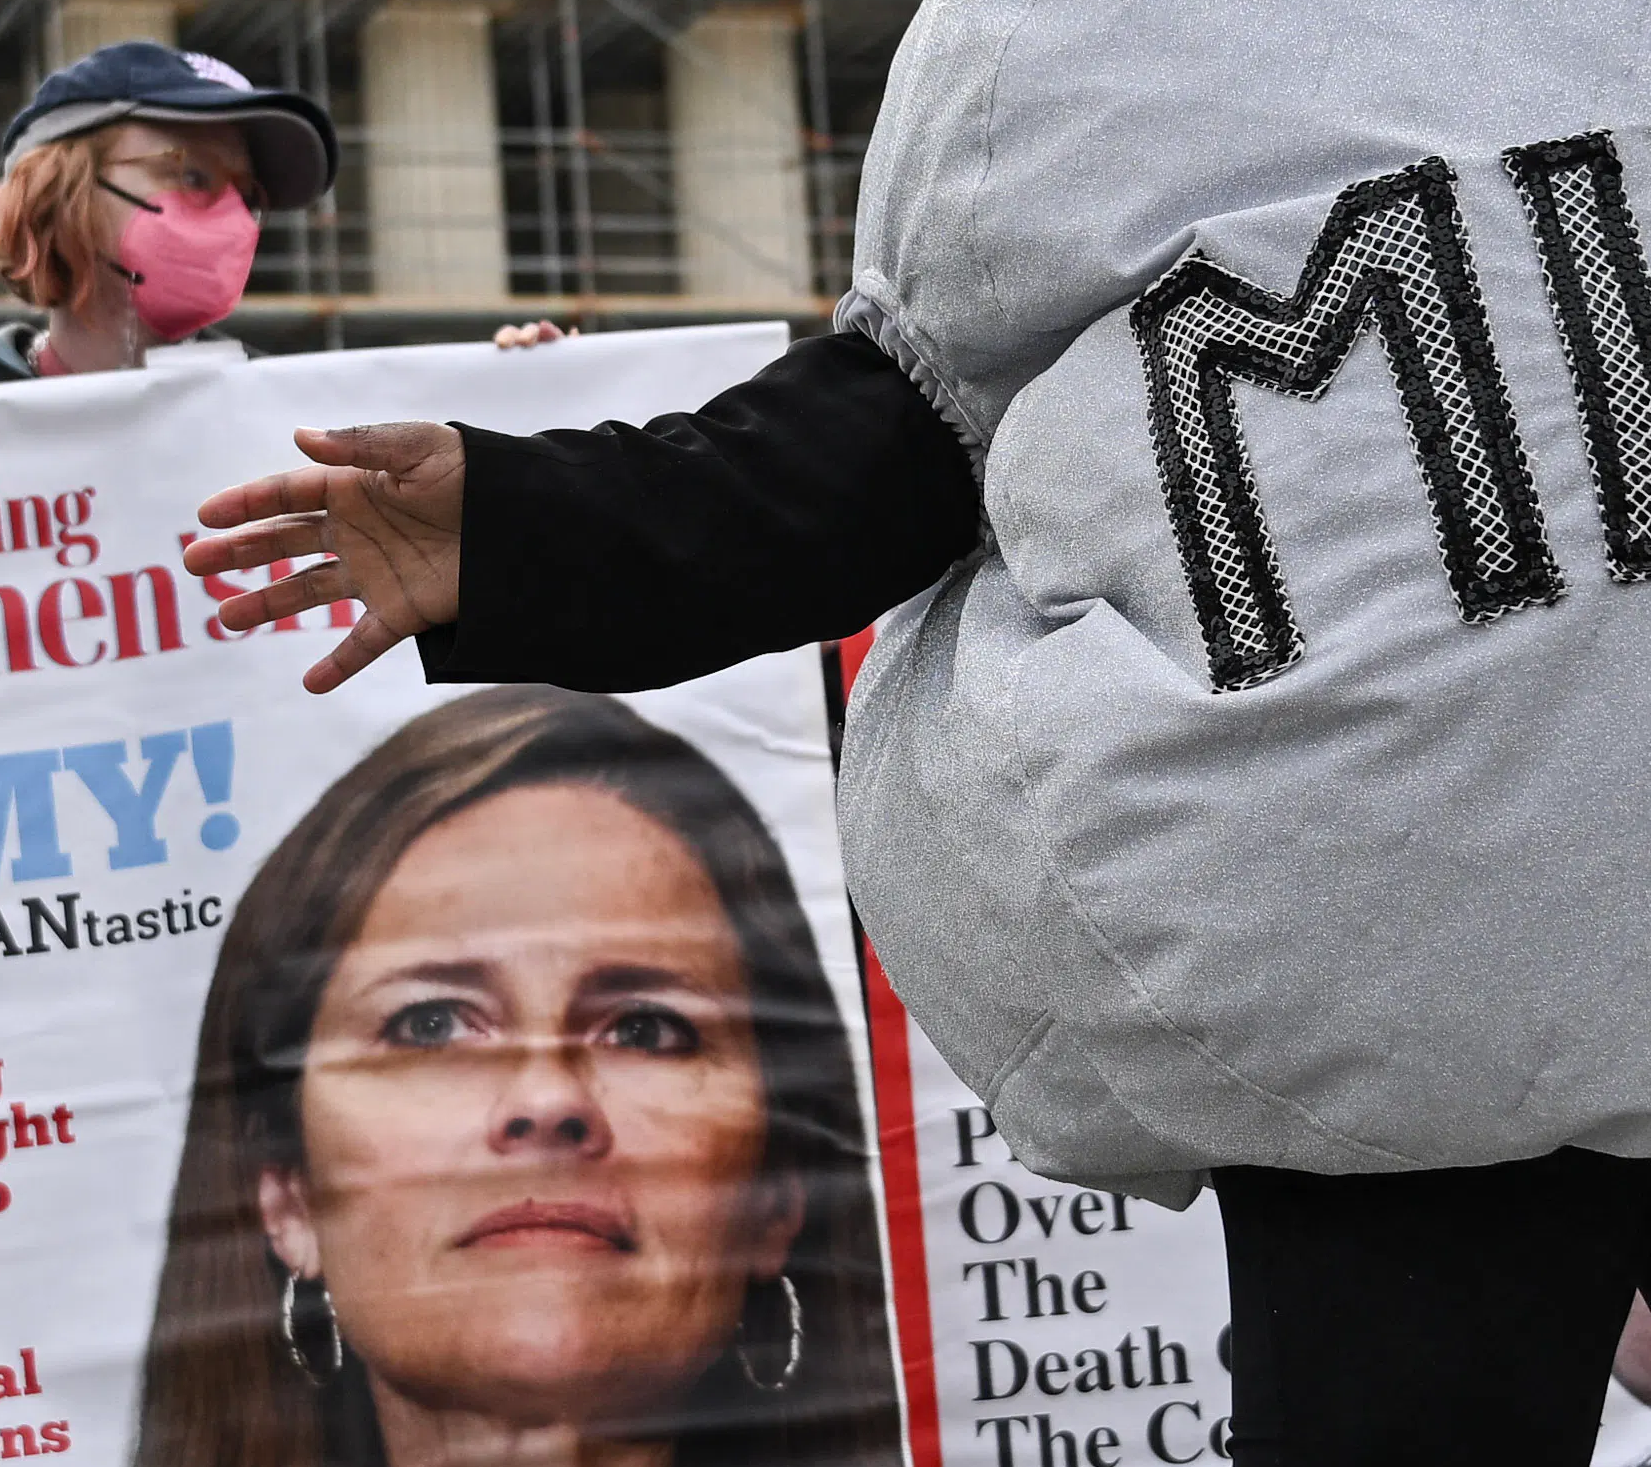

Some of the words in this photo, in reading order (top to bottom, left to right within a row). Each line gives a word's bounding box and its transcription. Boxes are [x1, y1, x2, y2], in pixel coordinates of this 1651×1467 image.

[958, 1181, 1141, 1244] Over
[963, 1257, 1108, 1322] The
[969, 1326, 1193, 1401] Death
